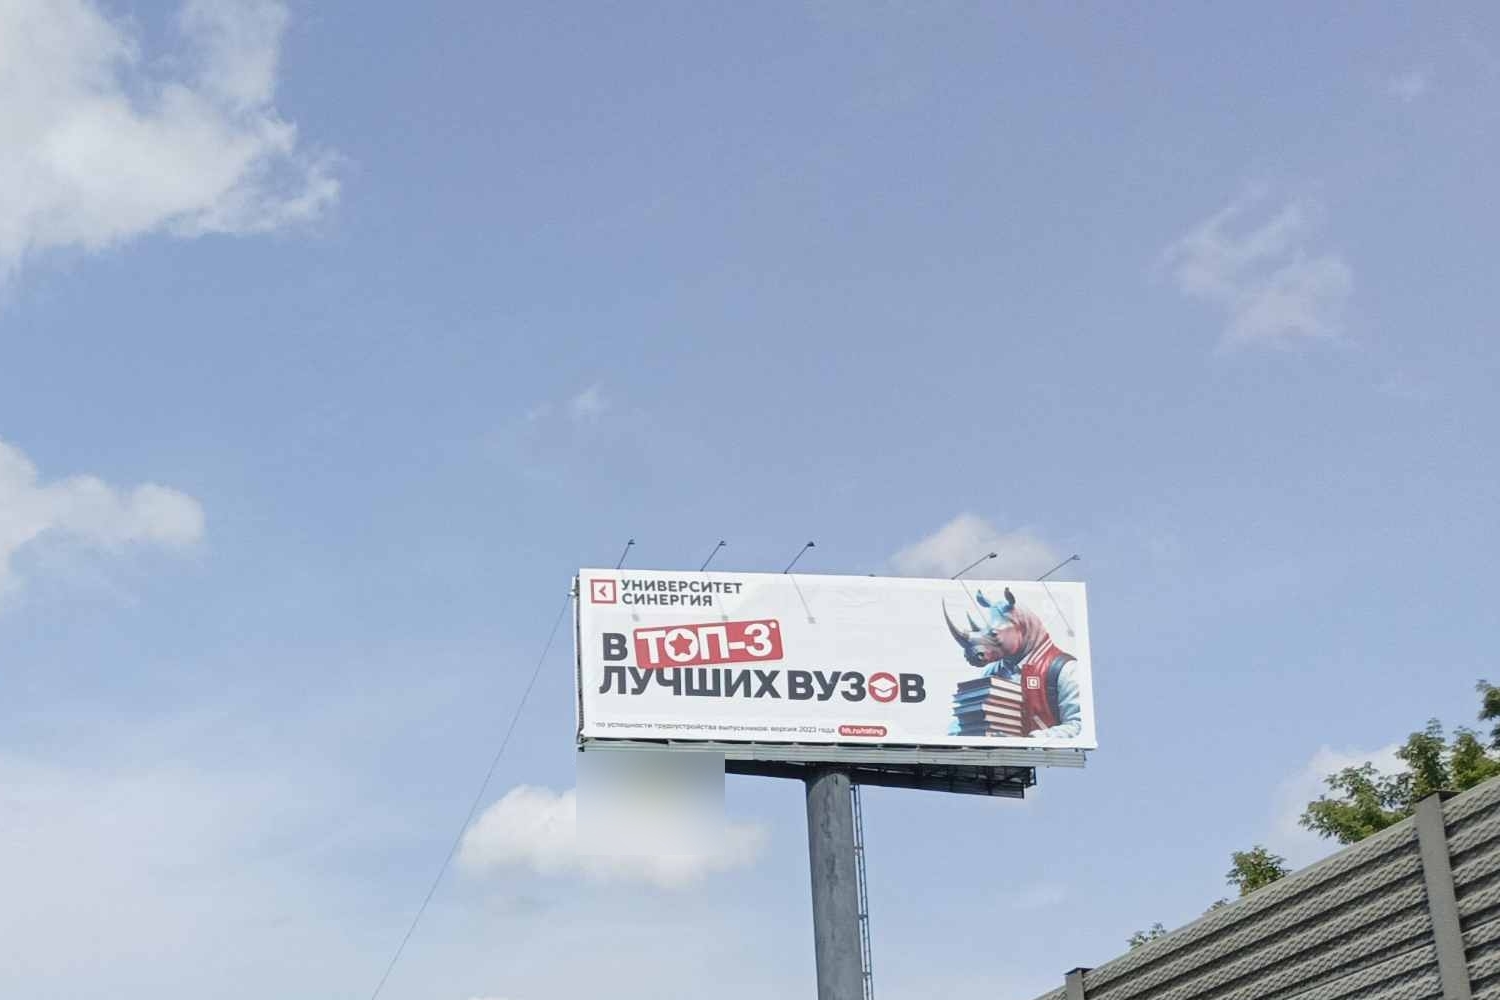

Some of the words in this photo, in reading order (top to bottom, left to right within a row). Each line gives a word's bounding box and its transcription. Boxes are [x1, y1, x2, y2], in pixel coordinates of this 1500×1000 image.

[621, 579, 743, 594] УНИВЕРСИТЕТ
[622, 593, 713, 607] СИНЕРГИЯ
[602, 632, 629, 661] В
[599, 665, 782, 699] ЛУЧШИХ
[787, 670, 926, 704] ВУЗОВ
